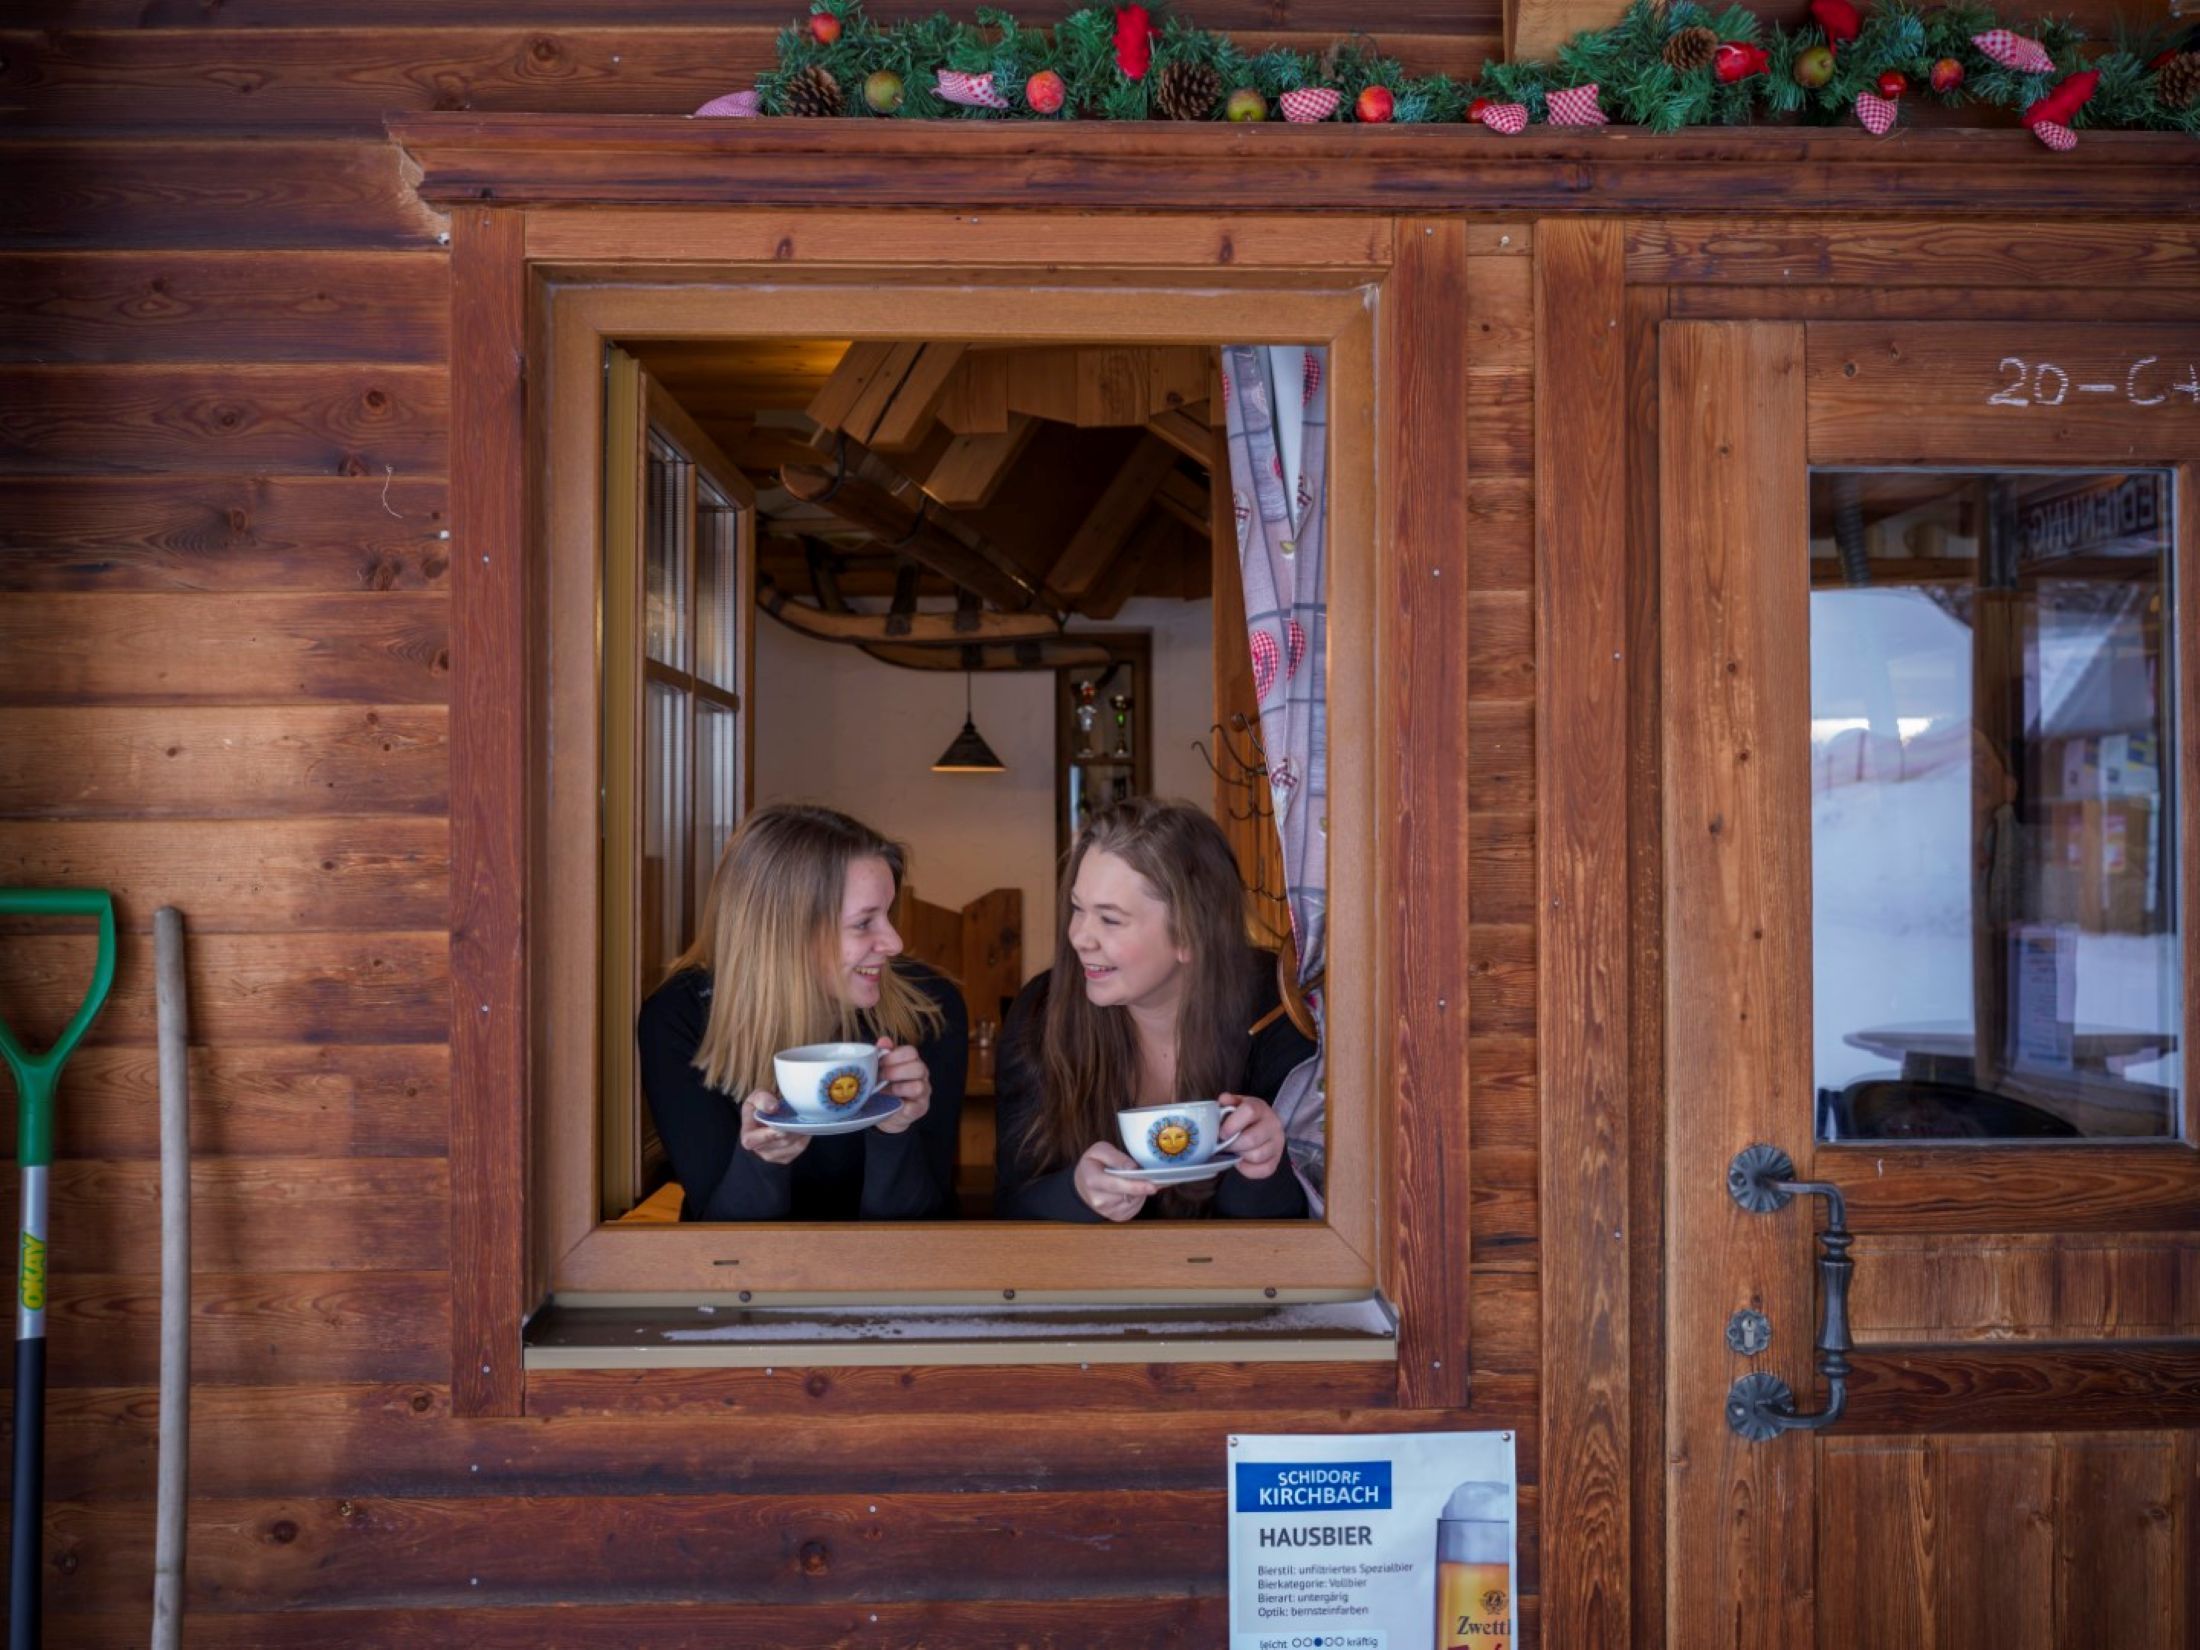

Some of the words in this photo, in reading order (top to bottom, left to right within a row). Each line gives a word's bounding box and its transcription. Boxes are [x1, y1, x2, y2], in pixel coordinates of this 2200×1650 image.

[21, 1231, 47, 1311] OKAY
[1277, 1469, 1362, 1487] SCHIDORF
[1259, 1485, 1379, 1506] KIRCHBACH
[1259, 1525, 1373, 1548] HAUSBIER
[1257, 1565, 1296, 1576] Bierstil:
[1299, 1564, 1357, 1575] unfiltriertes
[1359, 1562, 1414, 1575] Spezialbier
[1257, 1578, 1327, 1590] Bierkategorie:
[1329, 1577, 1367, 1588] Vollbier
[1257, 1593, 1294, 1603] Bierart:
[1297, 1592, 1349, 1603] untergärig
[1257, 1607, 1289, 1618] Optik:
[1291, 1605, 1369, 1617] bernsteinfarben
[1259, 1640, 1288, 1650] leicht
[1346, 1637, 1379, 1648] kräftig
